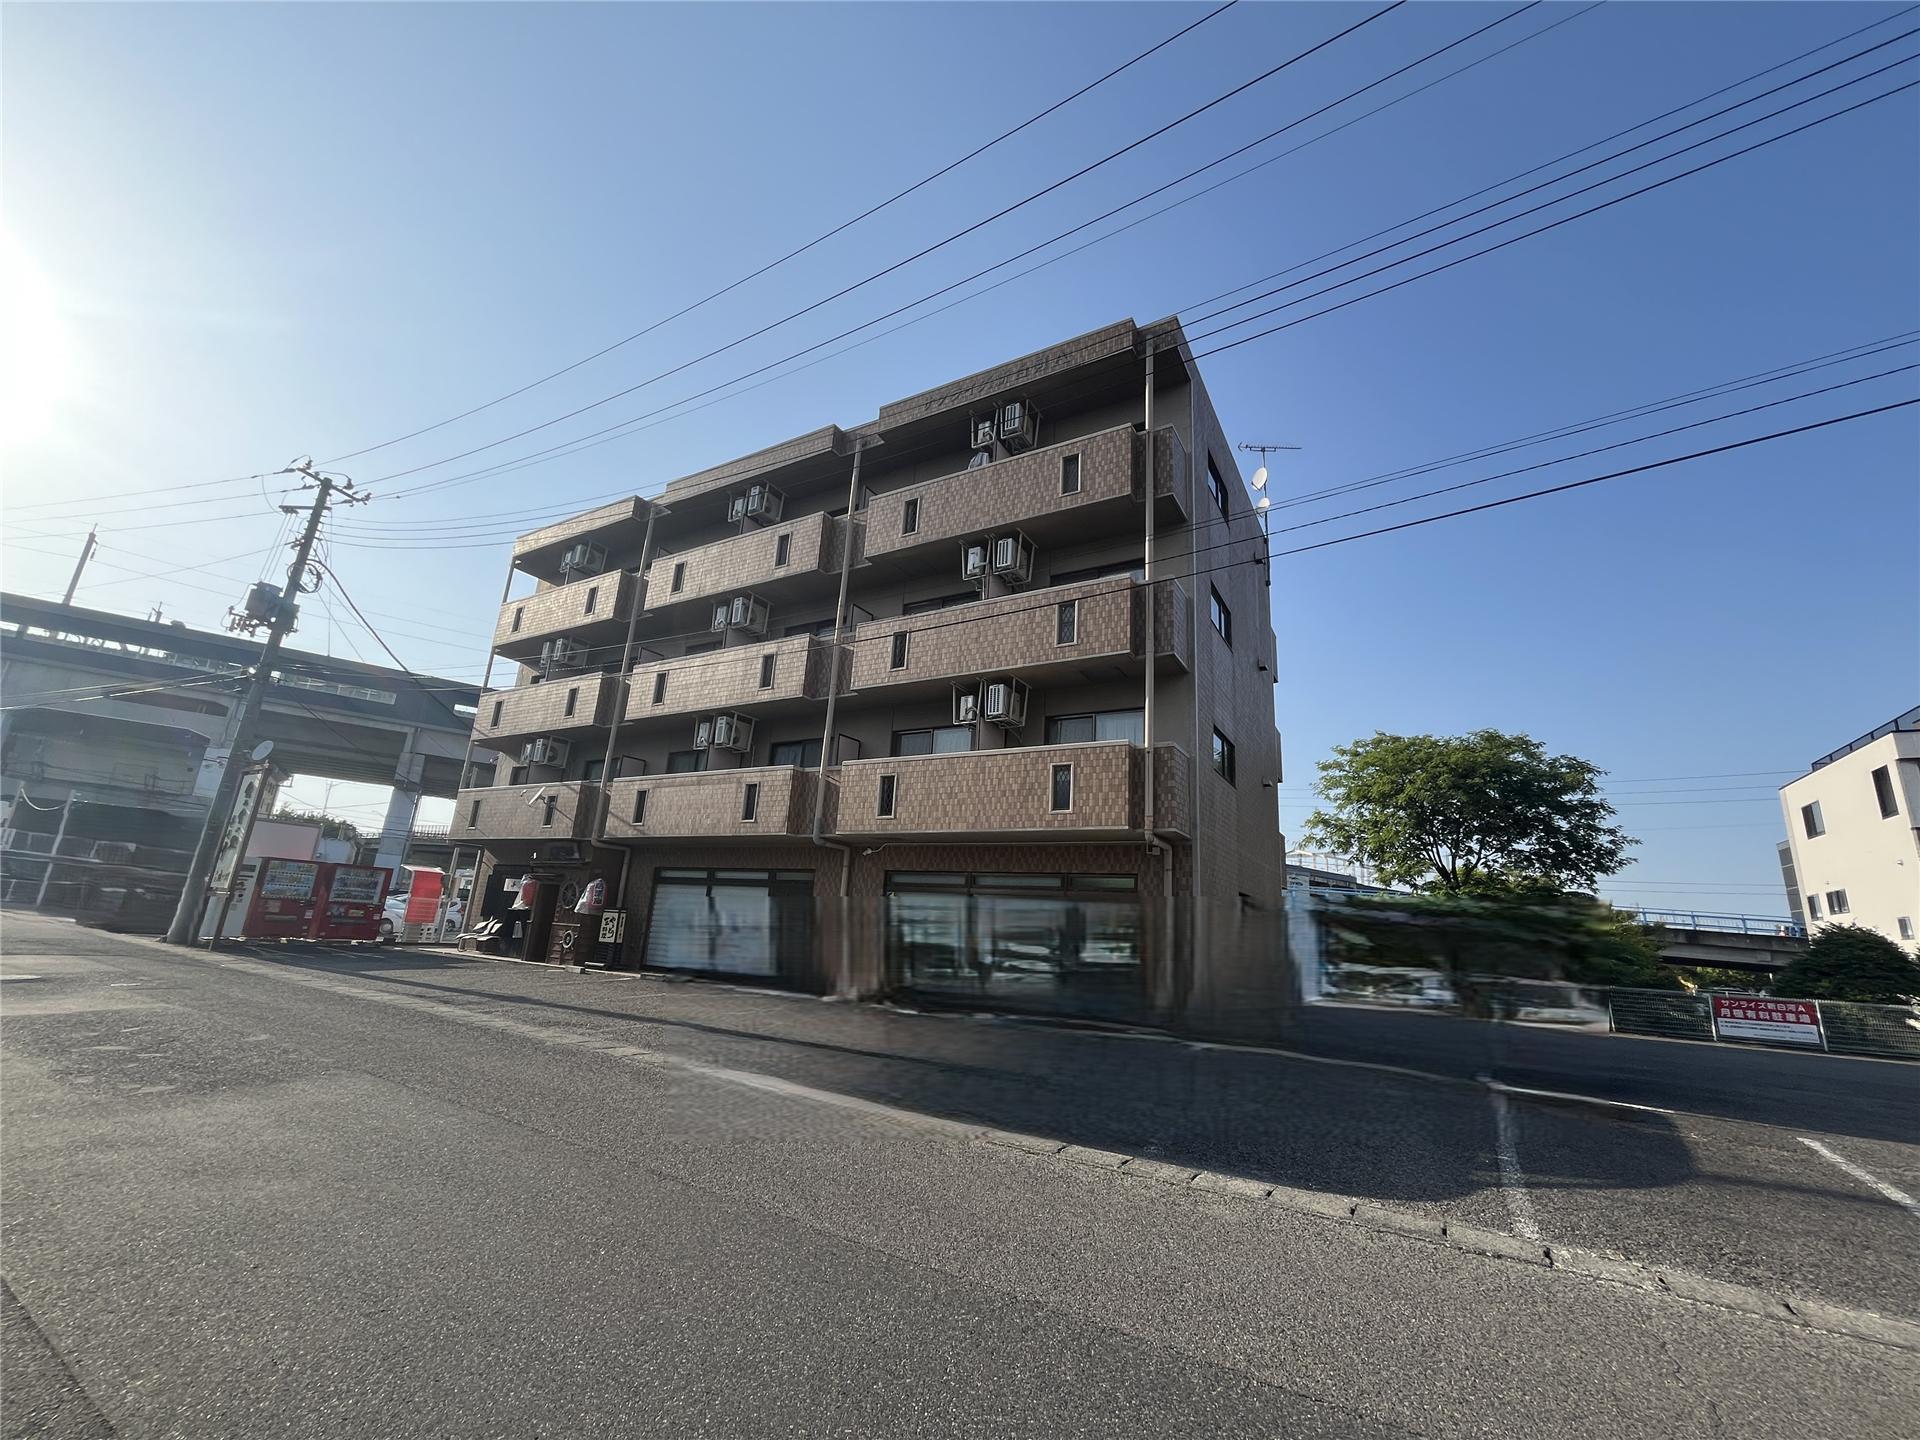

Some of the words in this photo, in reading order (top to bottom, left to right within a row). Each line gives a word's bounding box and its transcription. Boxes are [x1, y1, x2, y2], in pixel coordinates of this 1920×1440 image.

[1721, 1000, 1806, 1012] サンライズ新白河A
